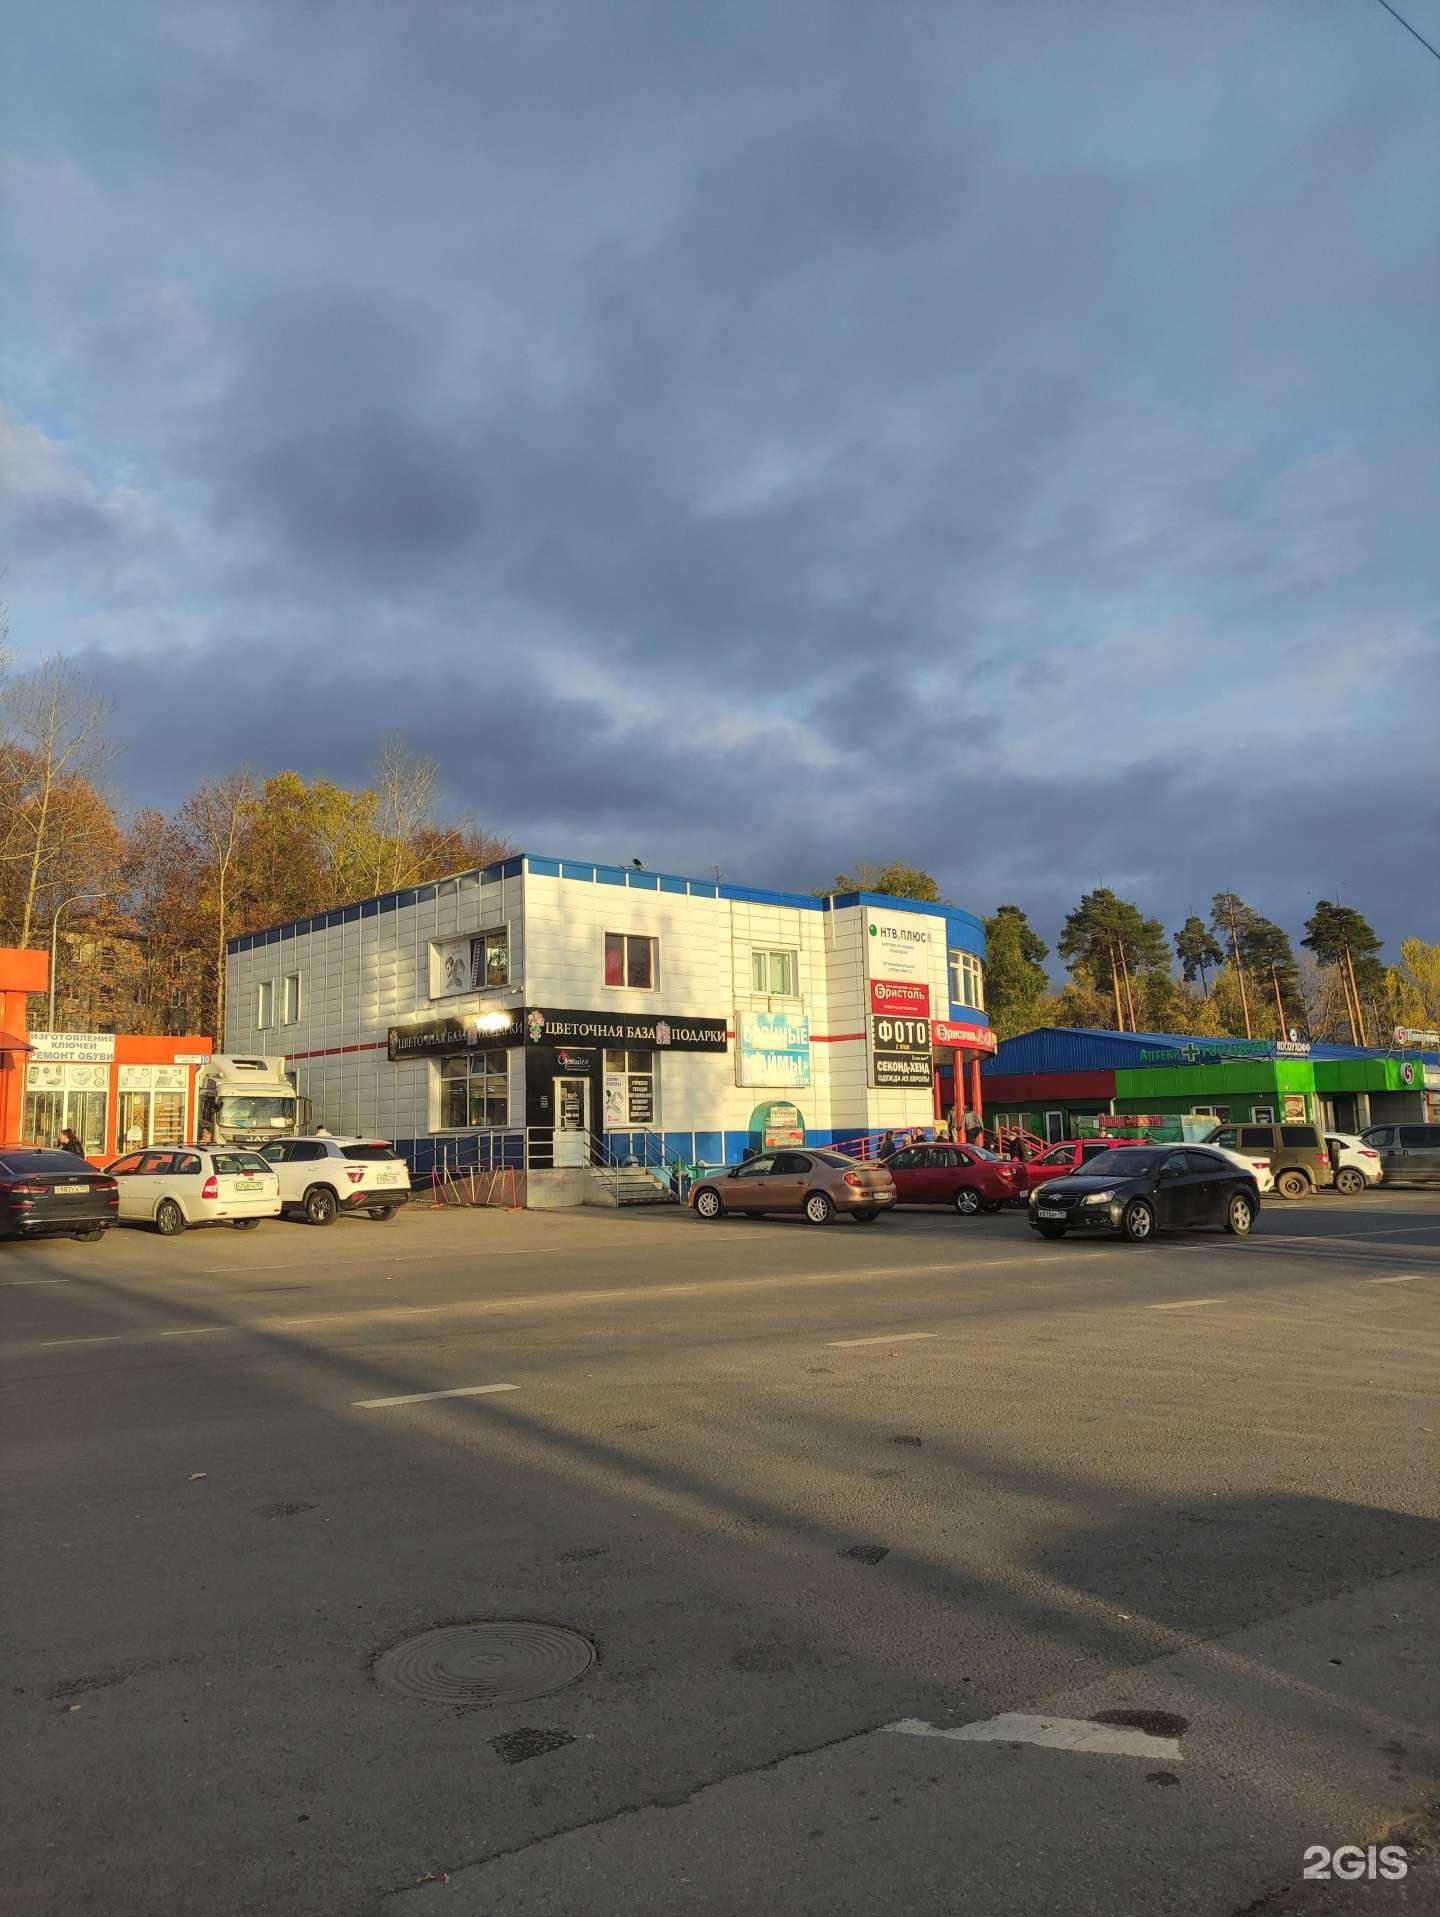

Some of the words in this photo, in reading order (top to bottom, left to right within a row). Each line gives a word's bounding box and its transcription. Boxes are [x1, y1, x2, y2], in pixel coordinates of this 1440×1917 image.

[875, 983, 926, 1000] Бристоль
[30, 1032, 114, 1043] ИЗГОТОВЛЕНИЕ
[545, 1021, 623, 1038] ЦВЕТОЧНАЯ
[627, 1026, 656, 1039] БАЗА
[671, 1028, 727, 1043] ПОДАРКИ
[878, 1020, 926, 1044] ФОТО
[51, 1041, 97, 1050] КЛЮЧЕЙ
[398, 1032, 446, 1049] ЦВЕТОЧНАЯ
[447, 1031, 466, 1044] БАЗА
[29, 1051, 74, 1060] РЕМОНТ
[78, 1052, 114, 1061] ОБУВИ
[877, 1060, 930, 1075] СЕКОНД-ХЕНД
[877, 1074, 901, 1084] ОДЕЖДА
